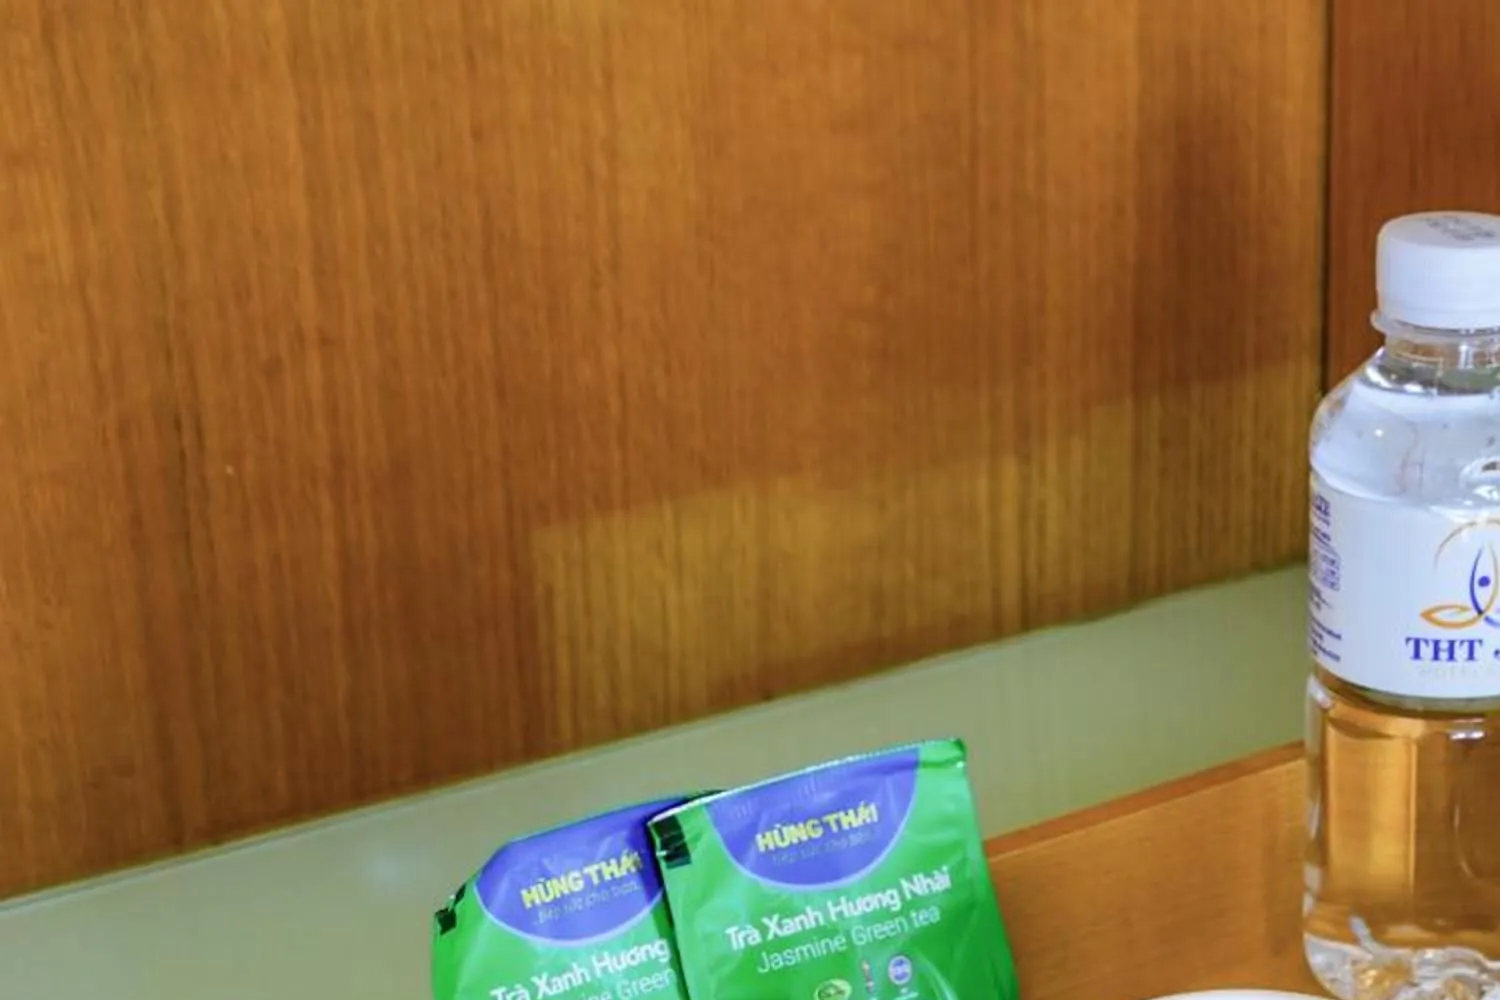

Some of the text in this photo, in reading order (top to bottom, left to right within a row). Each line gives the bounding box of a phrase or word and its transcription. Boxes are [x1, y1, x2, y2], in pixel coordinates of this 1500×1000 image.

[1405, 636, 1484, 662] THT
[724, 924, 763, 951] Trà
[761, 906, 826, 942] Xanh
[755, 905, 942, 974] Jasmine Green tea
[531, 963, 592, 1000] Xanh
